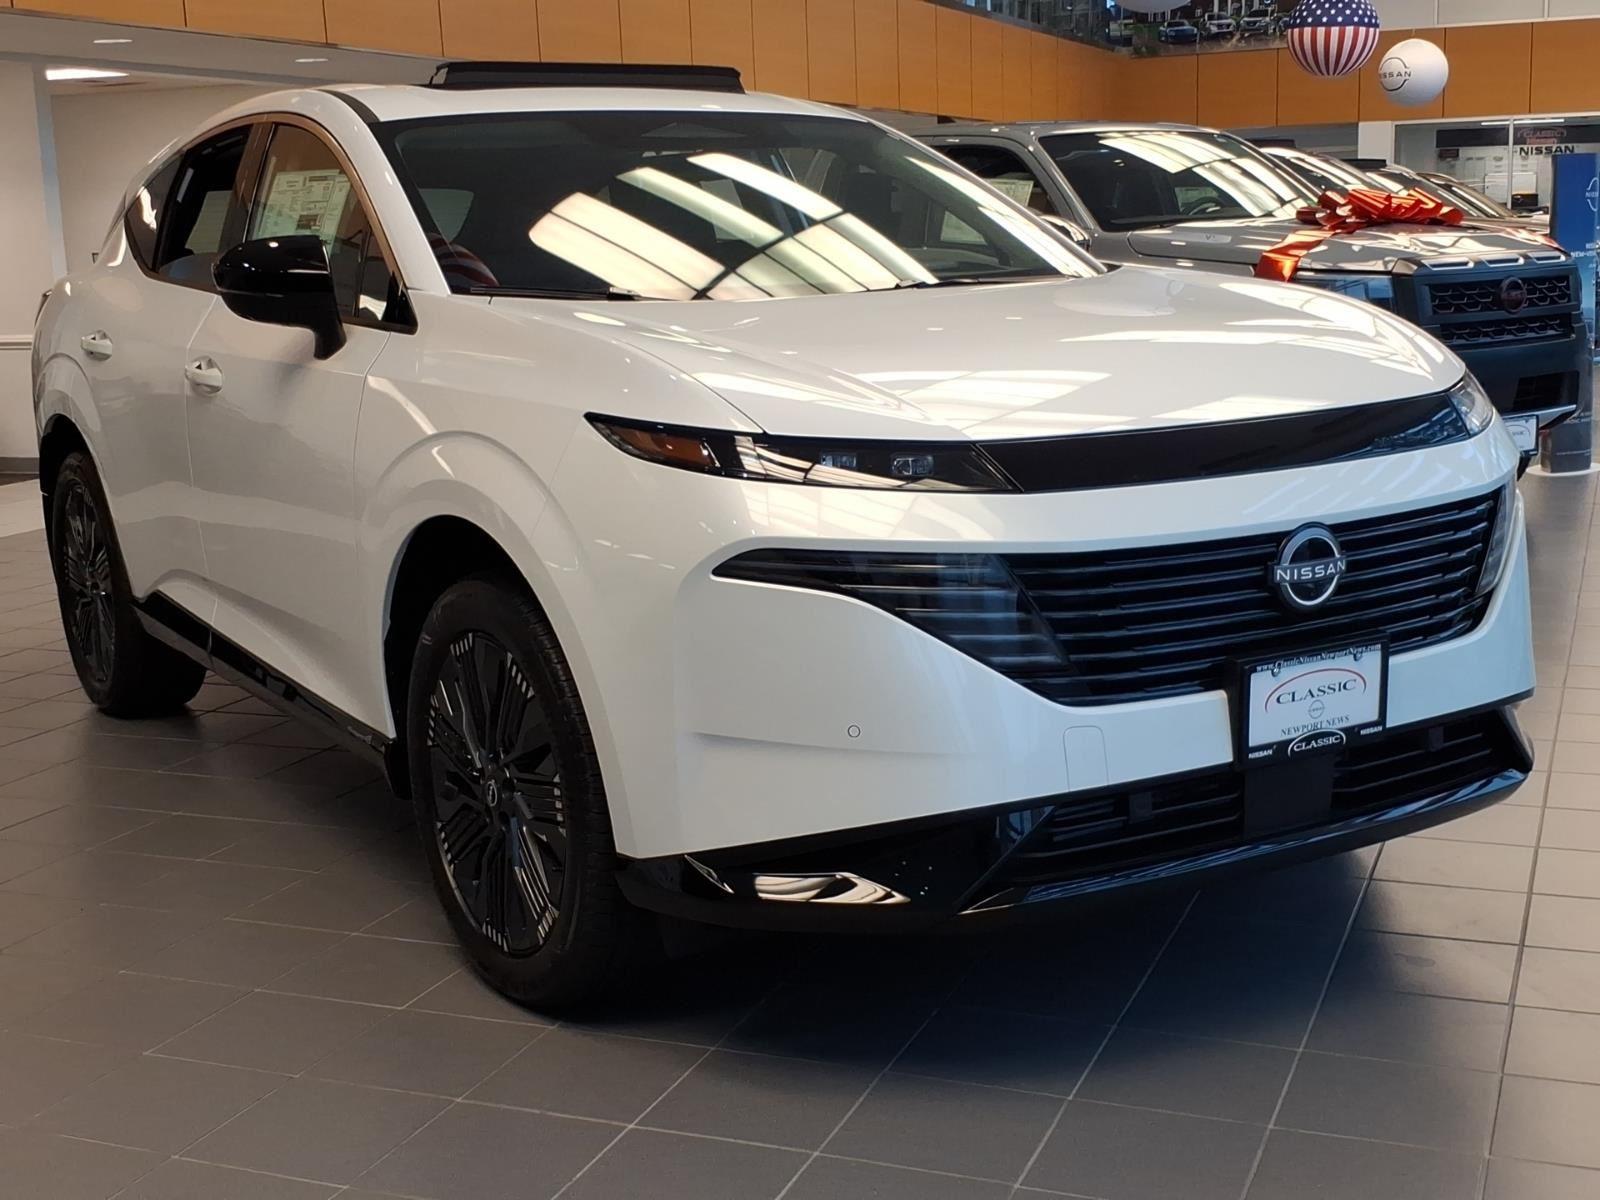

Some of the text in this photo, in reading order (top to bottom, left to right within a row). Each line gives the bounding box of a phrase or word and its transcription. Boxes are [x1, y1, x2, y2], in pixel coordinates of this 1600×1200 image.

[1519, 145, 1575, 156] NISSAN
[1276, 559, 1346, 581] NISSAN
[1276, 678, 1358, 705] CLASSIC
[1280, 714, 1351, 737] NEWPORT NEWS
[1360, 725, 1383, 736] NISSAN
[1293, 734, 1342, 752] CLASSIC
[1248, 748, 1273, 760] NISSAN
